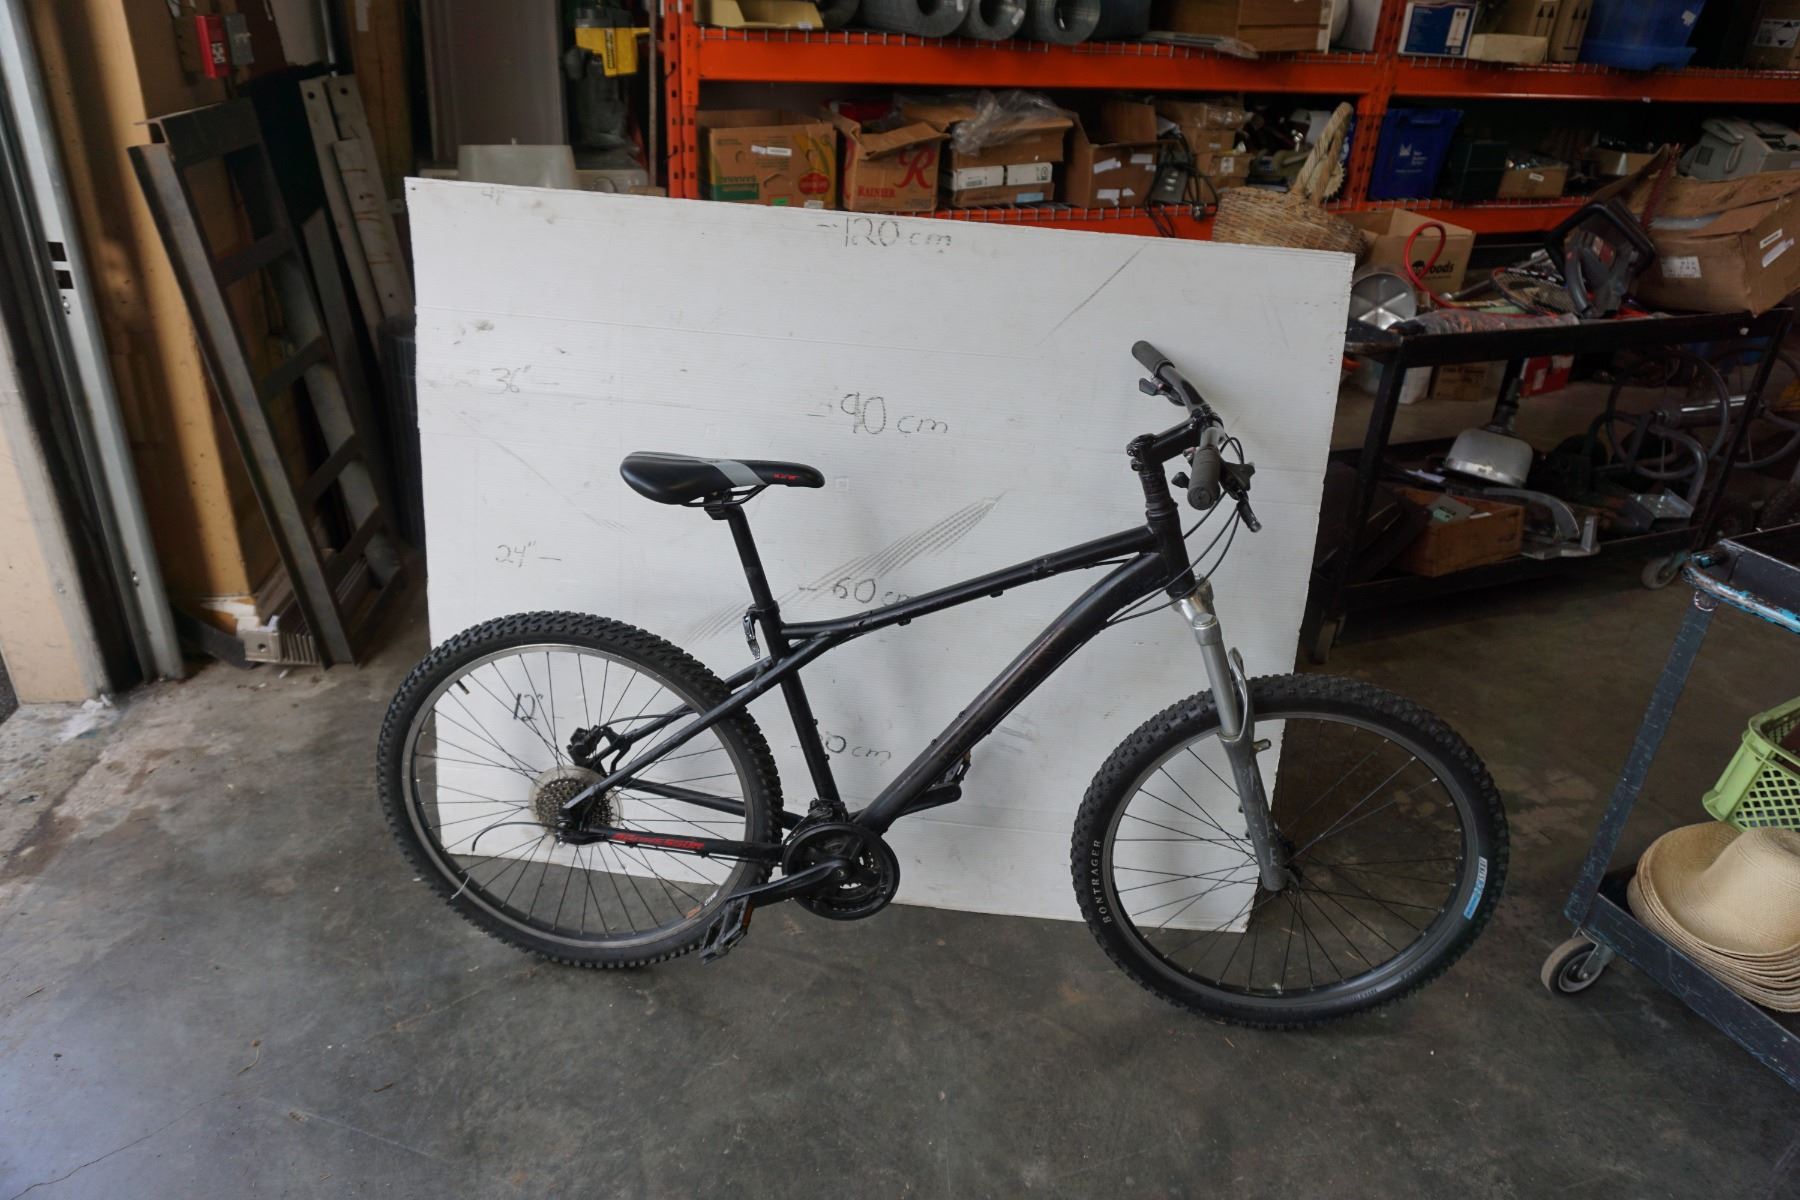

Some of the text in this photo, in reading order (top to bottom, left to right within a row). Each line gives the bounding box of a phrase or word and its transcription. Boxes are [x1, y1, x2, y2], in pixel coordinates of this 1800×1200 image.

[857, 185, 896, 198] RAINIER
[897, 415, 948, 434] cm
[1090, 840, 1113, 924] BONTRAGER
